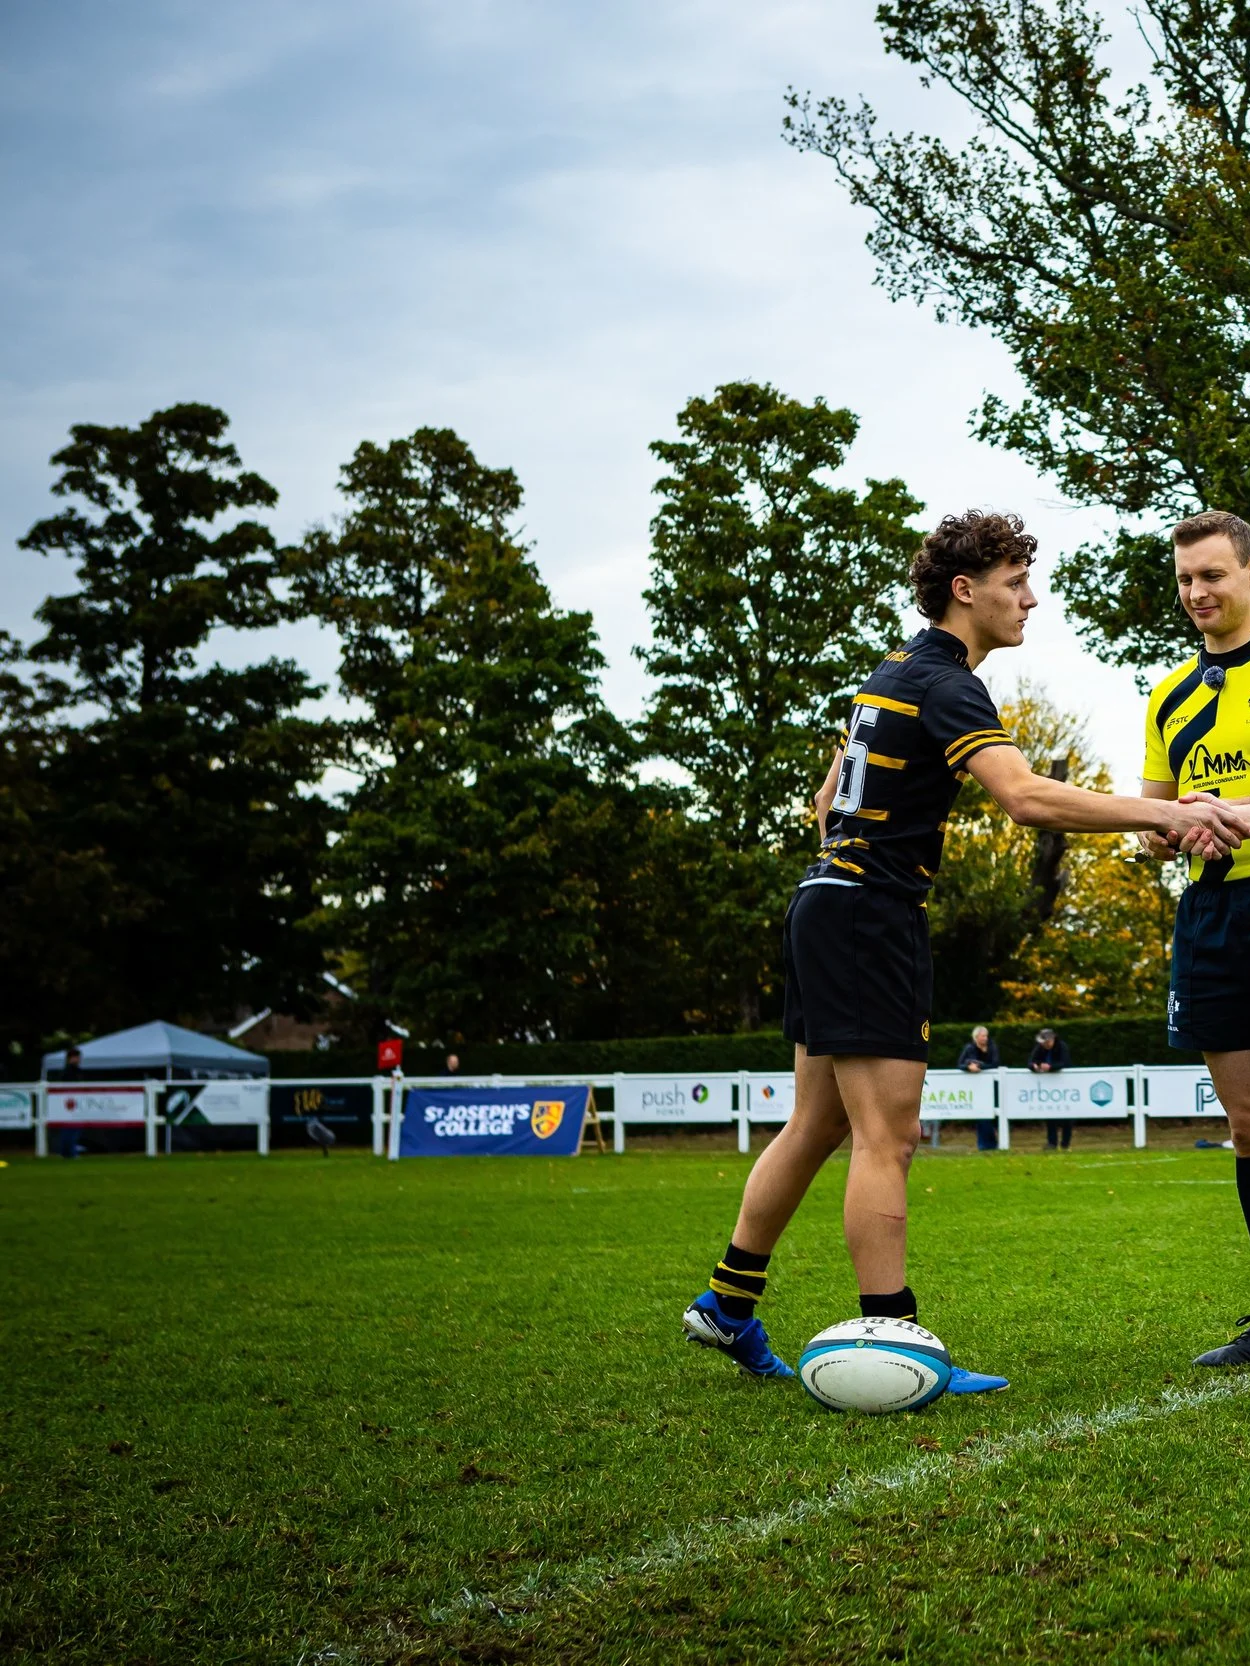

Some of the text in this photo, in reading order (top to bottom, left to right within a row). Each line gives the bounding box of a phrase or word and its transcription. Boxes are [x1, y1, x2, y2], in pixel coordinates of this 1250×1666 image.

[1189, 750, 1247, 781] LMM
[1193, 774, 1247, 789] BUILDING CONSULTANT
[642, 1083, 685, 1110] push
[1018, 1080, 1081, 1102] arbora
[443, 1104, 531, 1121] JOSEPH'S
[434, 1120, 516, 1136] COLLEGE
